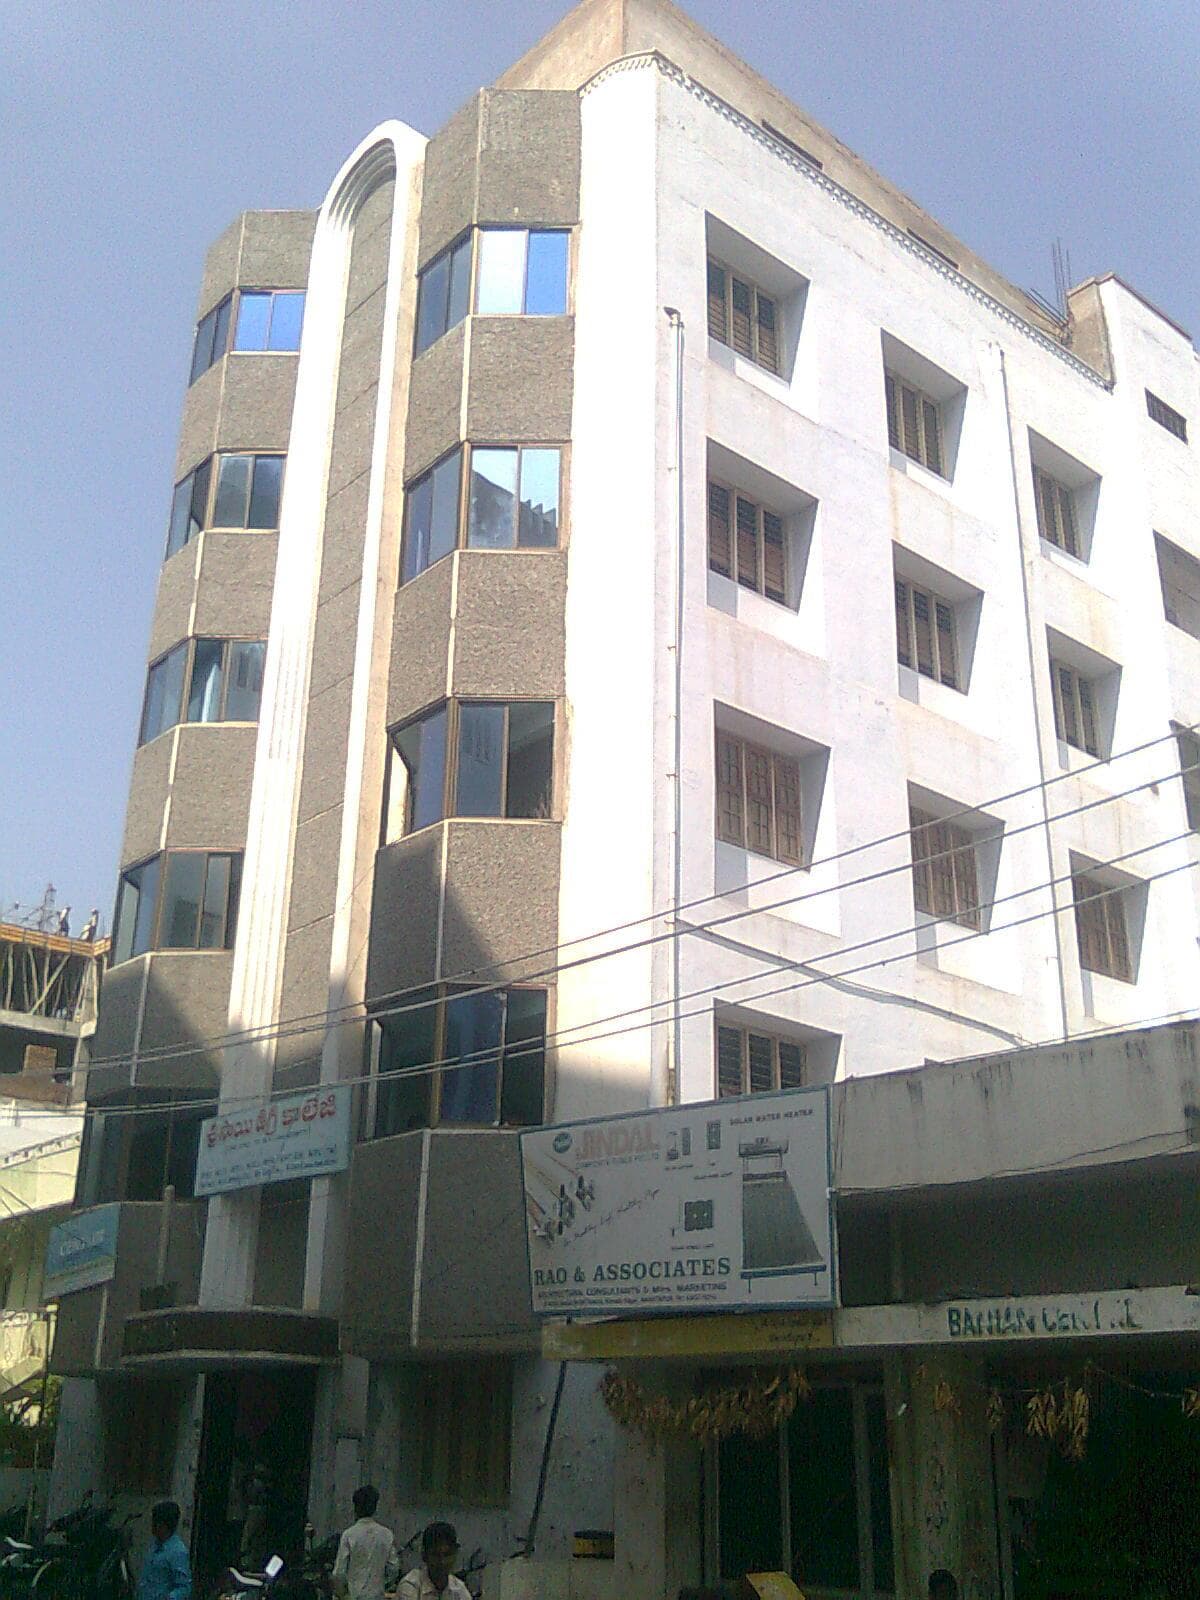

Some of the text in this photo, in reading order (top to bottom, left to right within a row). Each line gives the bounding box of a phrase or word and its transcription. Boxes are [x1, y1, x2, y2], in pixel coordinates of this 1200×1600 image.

[756, 1113, 781, 1123] WATER
[784, 1109, 814, 1120] HEATER
[576, 1121, 660, 1160] JINDAL
[534, 1256, 731, 1286] RAO & ASSOCIATES
